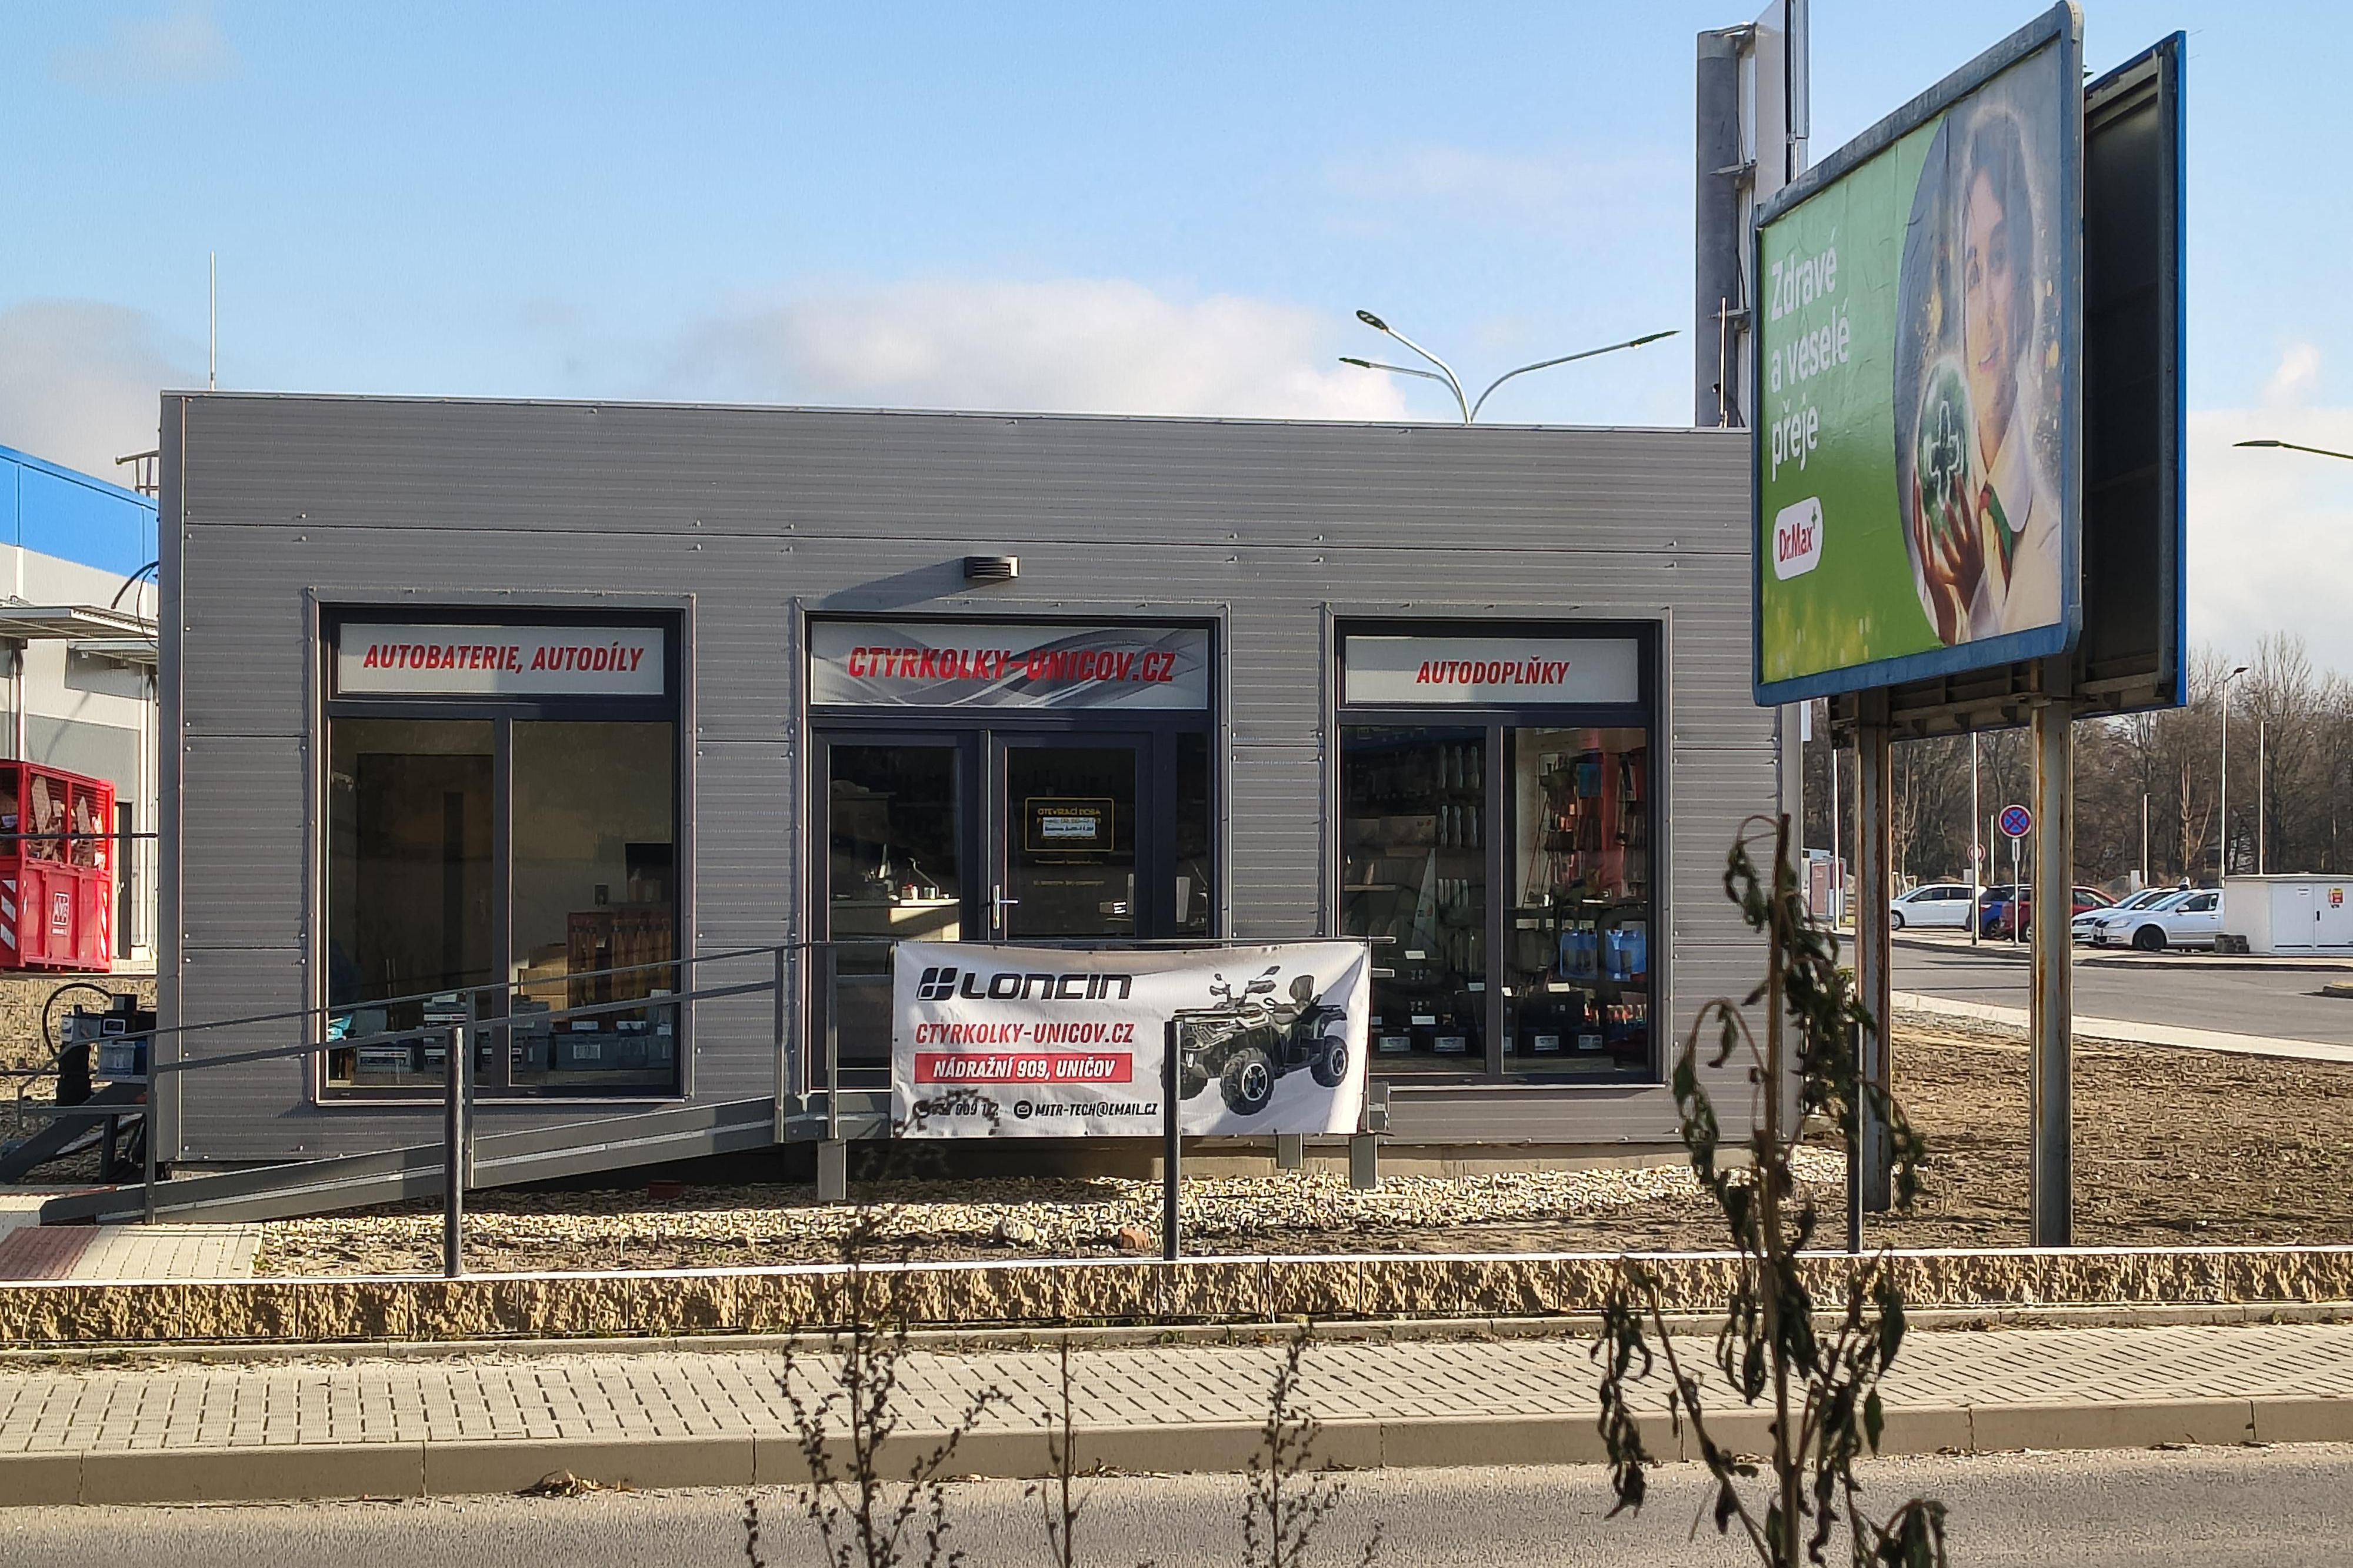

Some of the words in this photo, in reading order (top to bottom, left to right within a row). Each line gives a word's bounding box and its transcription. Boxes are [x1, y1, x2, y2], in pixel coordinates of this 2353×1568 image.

[1771, 226, 1838, 321] Zdravé
[1771, 347, 1782, 393] a
[1787, 297, 1850, 386] veselé
[1771, 392, 1819, 482] přeje
[1779, 522, 1812, 562] Dr.Max
[363, 644, 524, 674] AUTOBATERIE,
[531, 641, 645, 672] AUTODÍLY
[848, 646, 1177, 683] CTYRKOLKY-UNICOV.CZ
[1417, 655, 1570, 684] AUTODOPLŇKY
[960, 972, 1132, 1000] LONCIN
[915, 1023, 1135, 1044] CTYRKOLKY-UNICOV.CZ
[933, 1056, 1015, 1077] NÁDRAŽNÍ
[1016, 1060, 1051, 1080] 909,
[1056, 1056, 1116, 1077] UNIČOV
